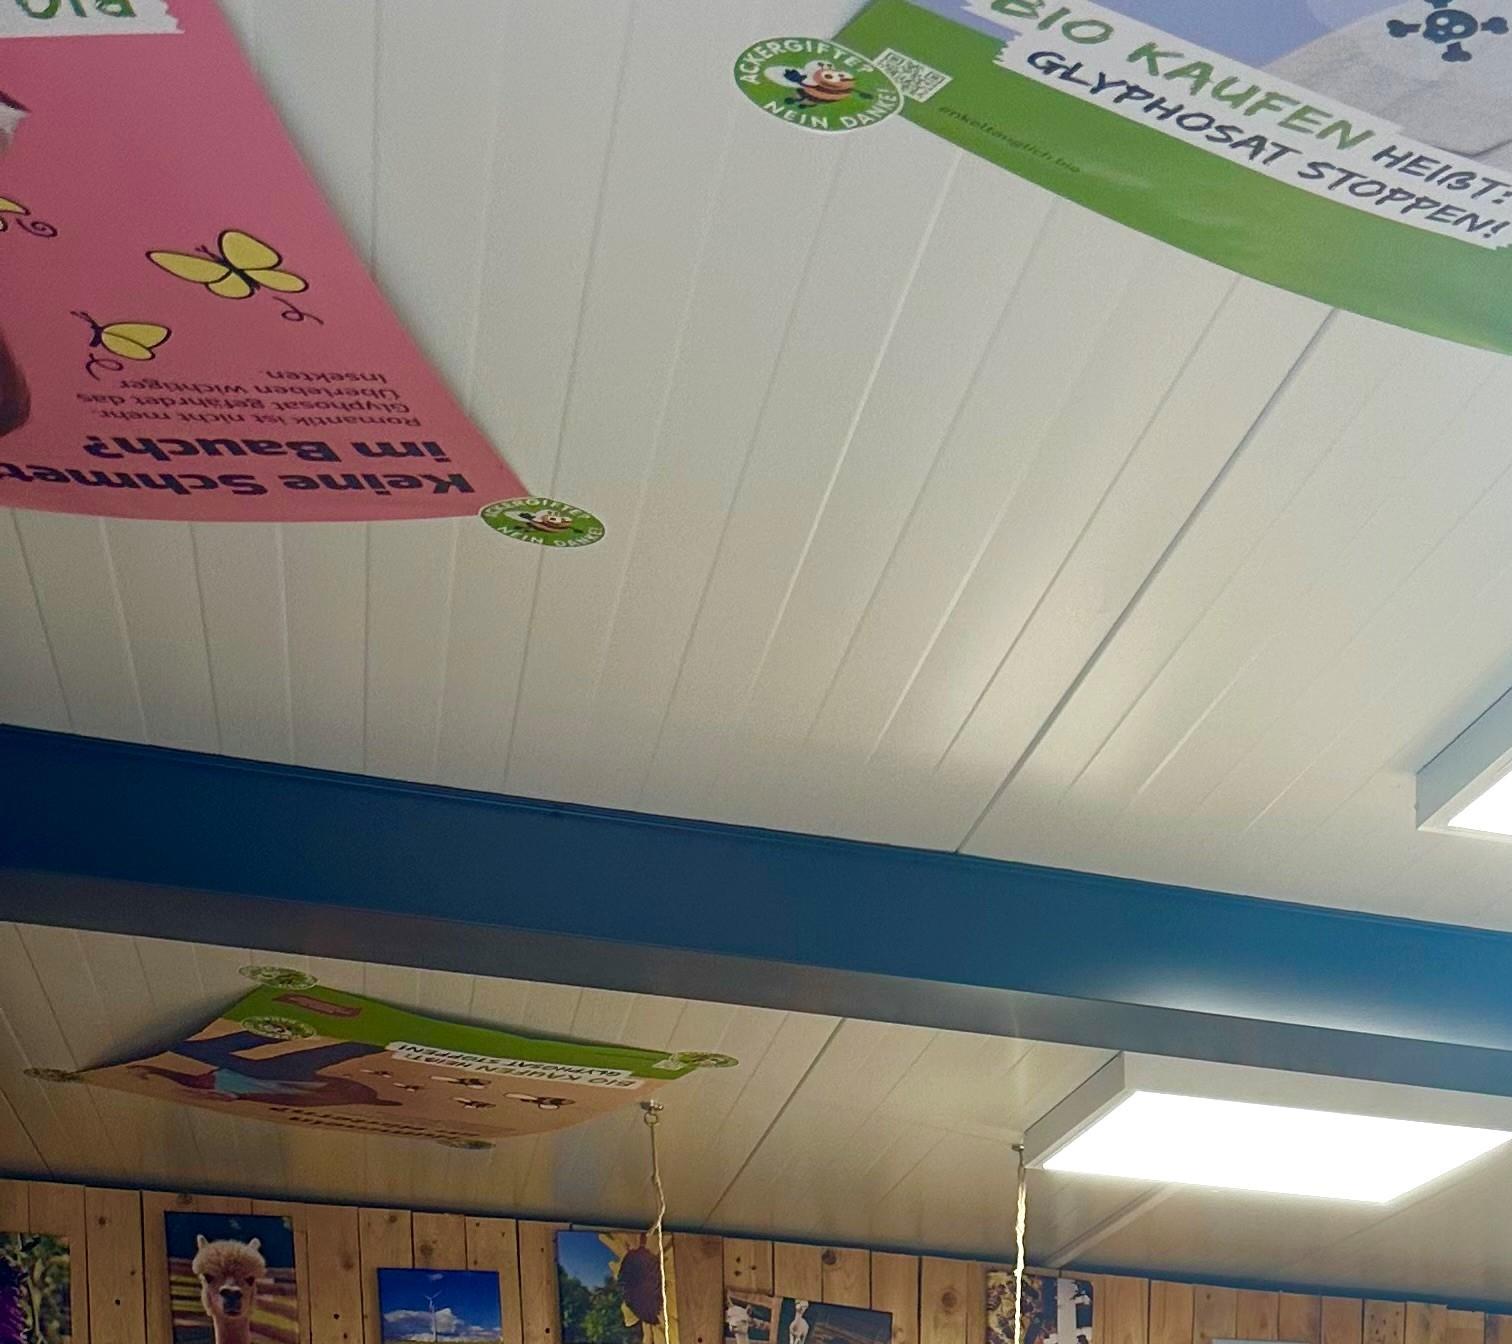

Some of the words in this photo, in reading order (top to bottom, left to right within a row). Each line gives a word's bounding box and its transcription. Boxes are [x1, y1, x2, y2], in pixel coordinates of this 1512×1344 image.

[990, 0, 1114, 45] BIO
[1127, 41, 1375, 150] KAUFEN
[764, 99, 830, 129] NEIN
[840, 87, 898, 130] DANKE!
[1027, 51, 1303, 166] GLYPHOSAT
[1298, 159, 1510, 239] STOPPEN!
[83, 434, 342, 463] Bauch?
[352, 439, 453, 463] im
[278, 472, 476, 496] Keine
